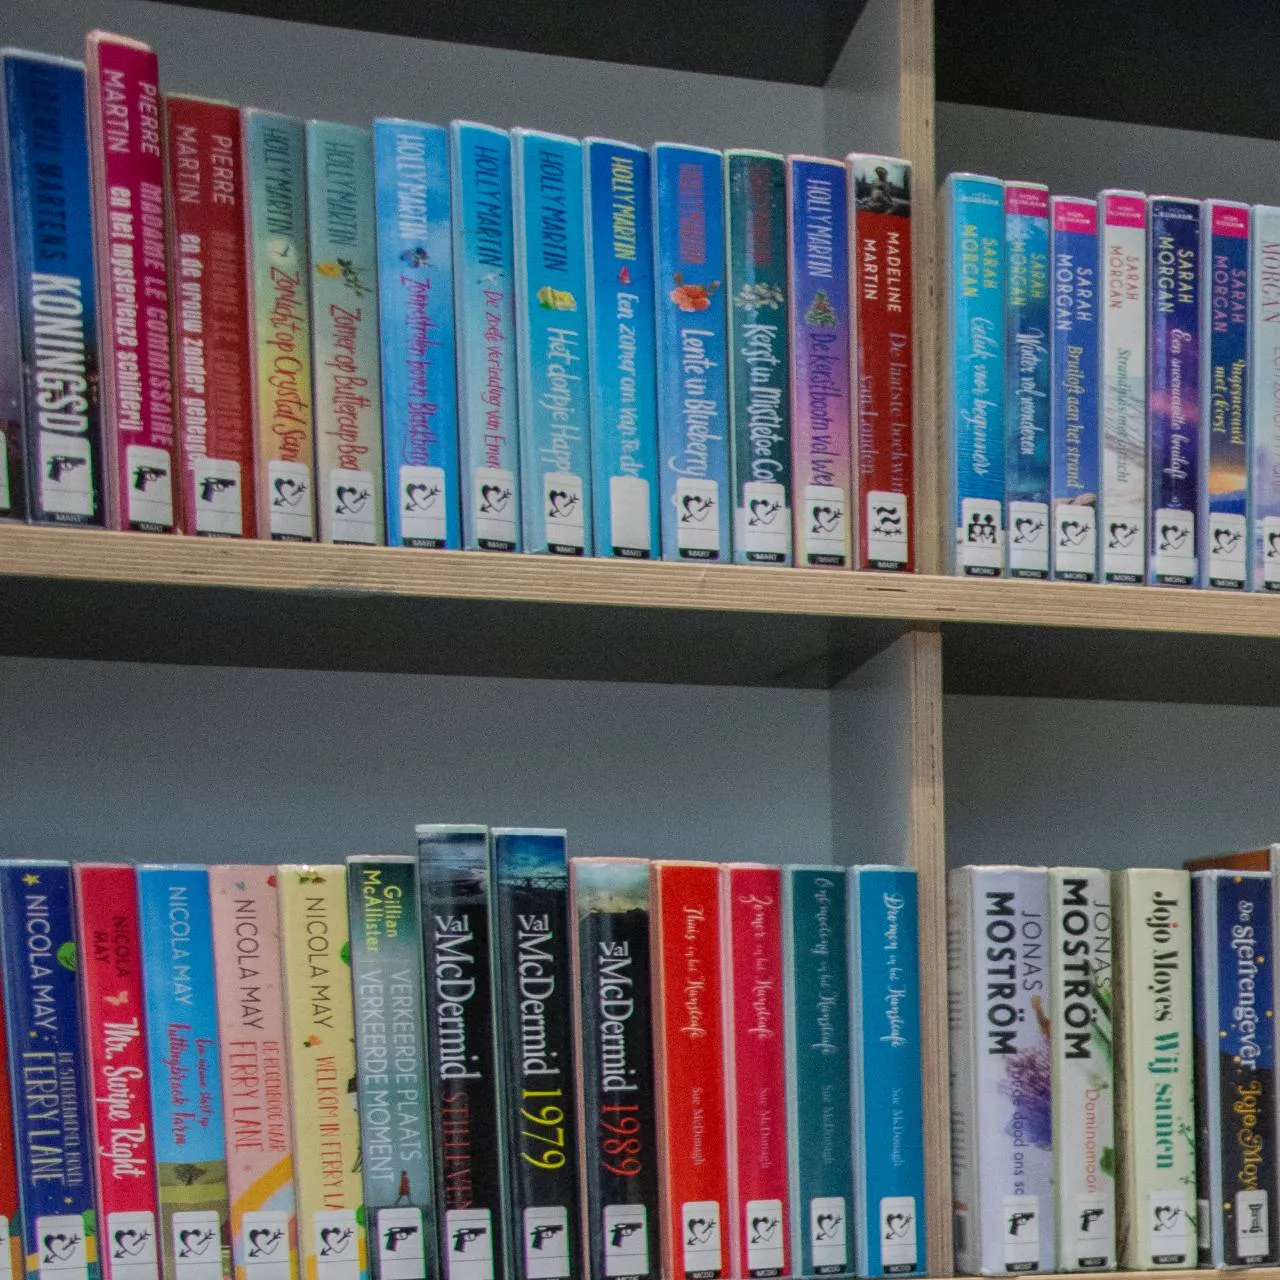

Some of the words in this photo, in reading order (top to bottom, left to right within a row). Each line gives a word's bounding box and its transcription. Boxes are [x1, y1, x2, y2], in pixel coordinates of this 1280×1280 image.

[104, 69, 130, 154] MARTIN
[137, 80, 160, 156] PIERRE
[862, 238, 879, 300] MARTIN
[886, 231, 903, 313] MADELINE
[1055, 254, 1073, 331] MORGAN
[1076, 267, 1093, 322] SARAH
[1157, 235, 1175, 313] MORGAN
[1178, 249, 1194, 304] SARAH
[25, 893, 51, 980] NICOLA
[169, 885, 191, 960] NICOLA
[235, 900, 260, 980] NICOLA
[305, 897, 330, 979] NICOLA
[383, 884, 402, 938] Gillian
[1021, 909, 1043, 992] JONAS
[1093, 901, 1112, 992] JONAS
[1146, 891, 1179, 944] Jojo
[32, 984, 58, 1027] MAY
[173, 965, 193, 1005] MAY
[240, 985, 265, 1029] MAY
[311, 985, 335, 1028] MAY
[435, 929, 483, 1081] McDermid
[516, 928, 559, 1076] McDermid
[984, 891, 1024, 1057] MOSTRÖM
[1061, 878, 1098, 1060] MOSTRÖM
[1147, 948, 1179, 1022] Moyes
[359, 970, 390, 1080] VERKEERDE
[388, 969, 416, 1074] VERKEERDE
[597, 956, 639, 1094] McDermid
[229, 1042, 260, 1103] FERRY
[234, 1107, 264, 1153] LANE
[364, 1084, 395, 1183] MOMENT
[394, 1078, 422, 1161] PLAATS
[520, 1088, 567, 1171] 1979
[600, 1104, 642, 1177] 1989
